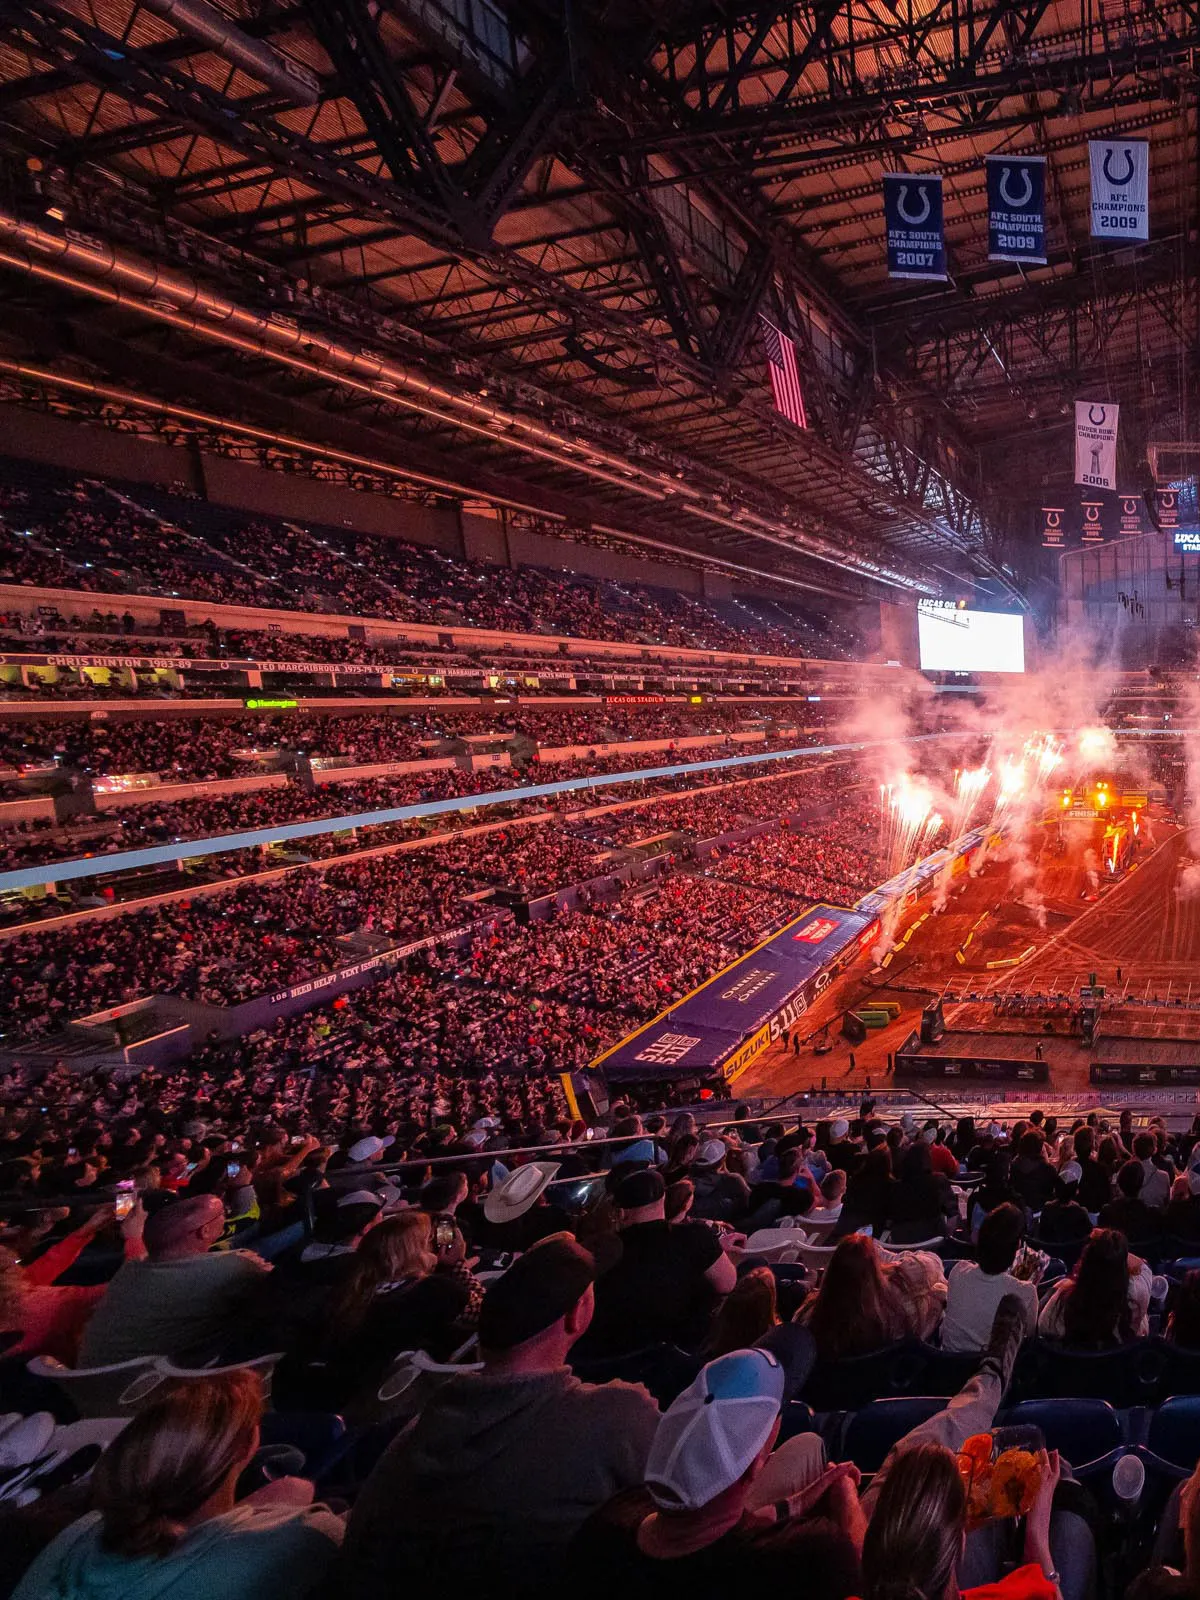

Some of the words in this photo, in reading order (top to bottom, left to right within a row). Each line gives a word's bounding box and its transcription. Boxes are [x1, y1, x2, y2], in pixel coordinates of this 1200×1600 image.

[1110, 194, 1128, 202] AFC
[1092, 202, 1146, 213] CHAMPIONS
[990, 211, 1008, 222] AFC
[1010, 212, 1041, 223] SOUTH
[1100, 215, 1137, 229] 2009
[990, 220, 1044, 232] CHAMPIONS
[889, 230, 907, 239] AFC
[909, 231, 940, 240] SOUTH
[888, 239, 942, 250] CHAMPIONS
[997, 234, 1035, 249] 2009
[896, 252, 934, 266] 2007
[1077, 424, 1098, 434] SUPER
[1078, 431, 1115, 441] CHAMPIONS
[1082, 474, 1109, 487] 2006
[919, 599, 943, 608] LUCAS
[944, 601, 956, 609] OIL
[46, 656, 89, 666] CHRIS
[93, 658, 141, 667] HINTON
[149, 659, 192, 669] 1983-89
[257, 663, 275, 671] TED
[277, 663, 340, 672] MARCHIBRODA
[291, 983, 312, 998] NEED
[313, 975, 337, 992] HELP?
[340, 968, 359, 979] TEXT
[731, 969, 760, 991] OAKLEY
[748, 972, 776, 994] OAKLEY
[271, 993, 287, 1003] 108
[770, 1004, 797, 1041] 5.11
[726, 1031, 770, 1077] SUZUKI
